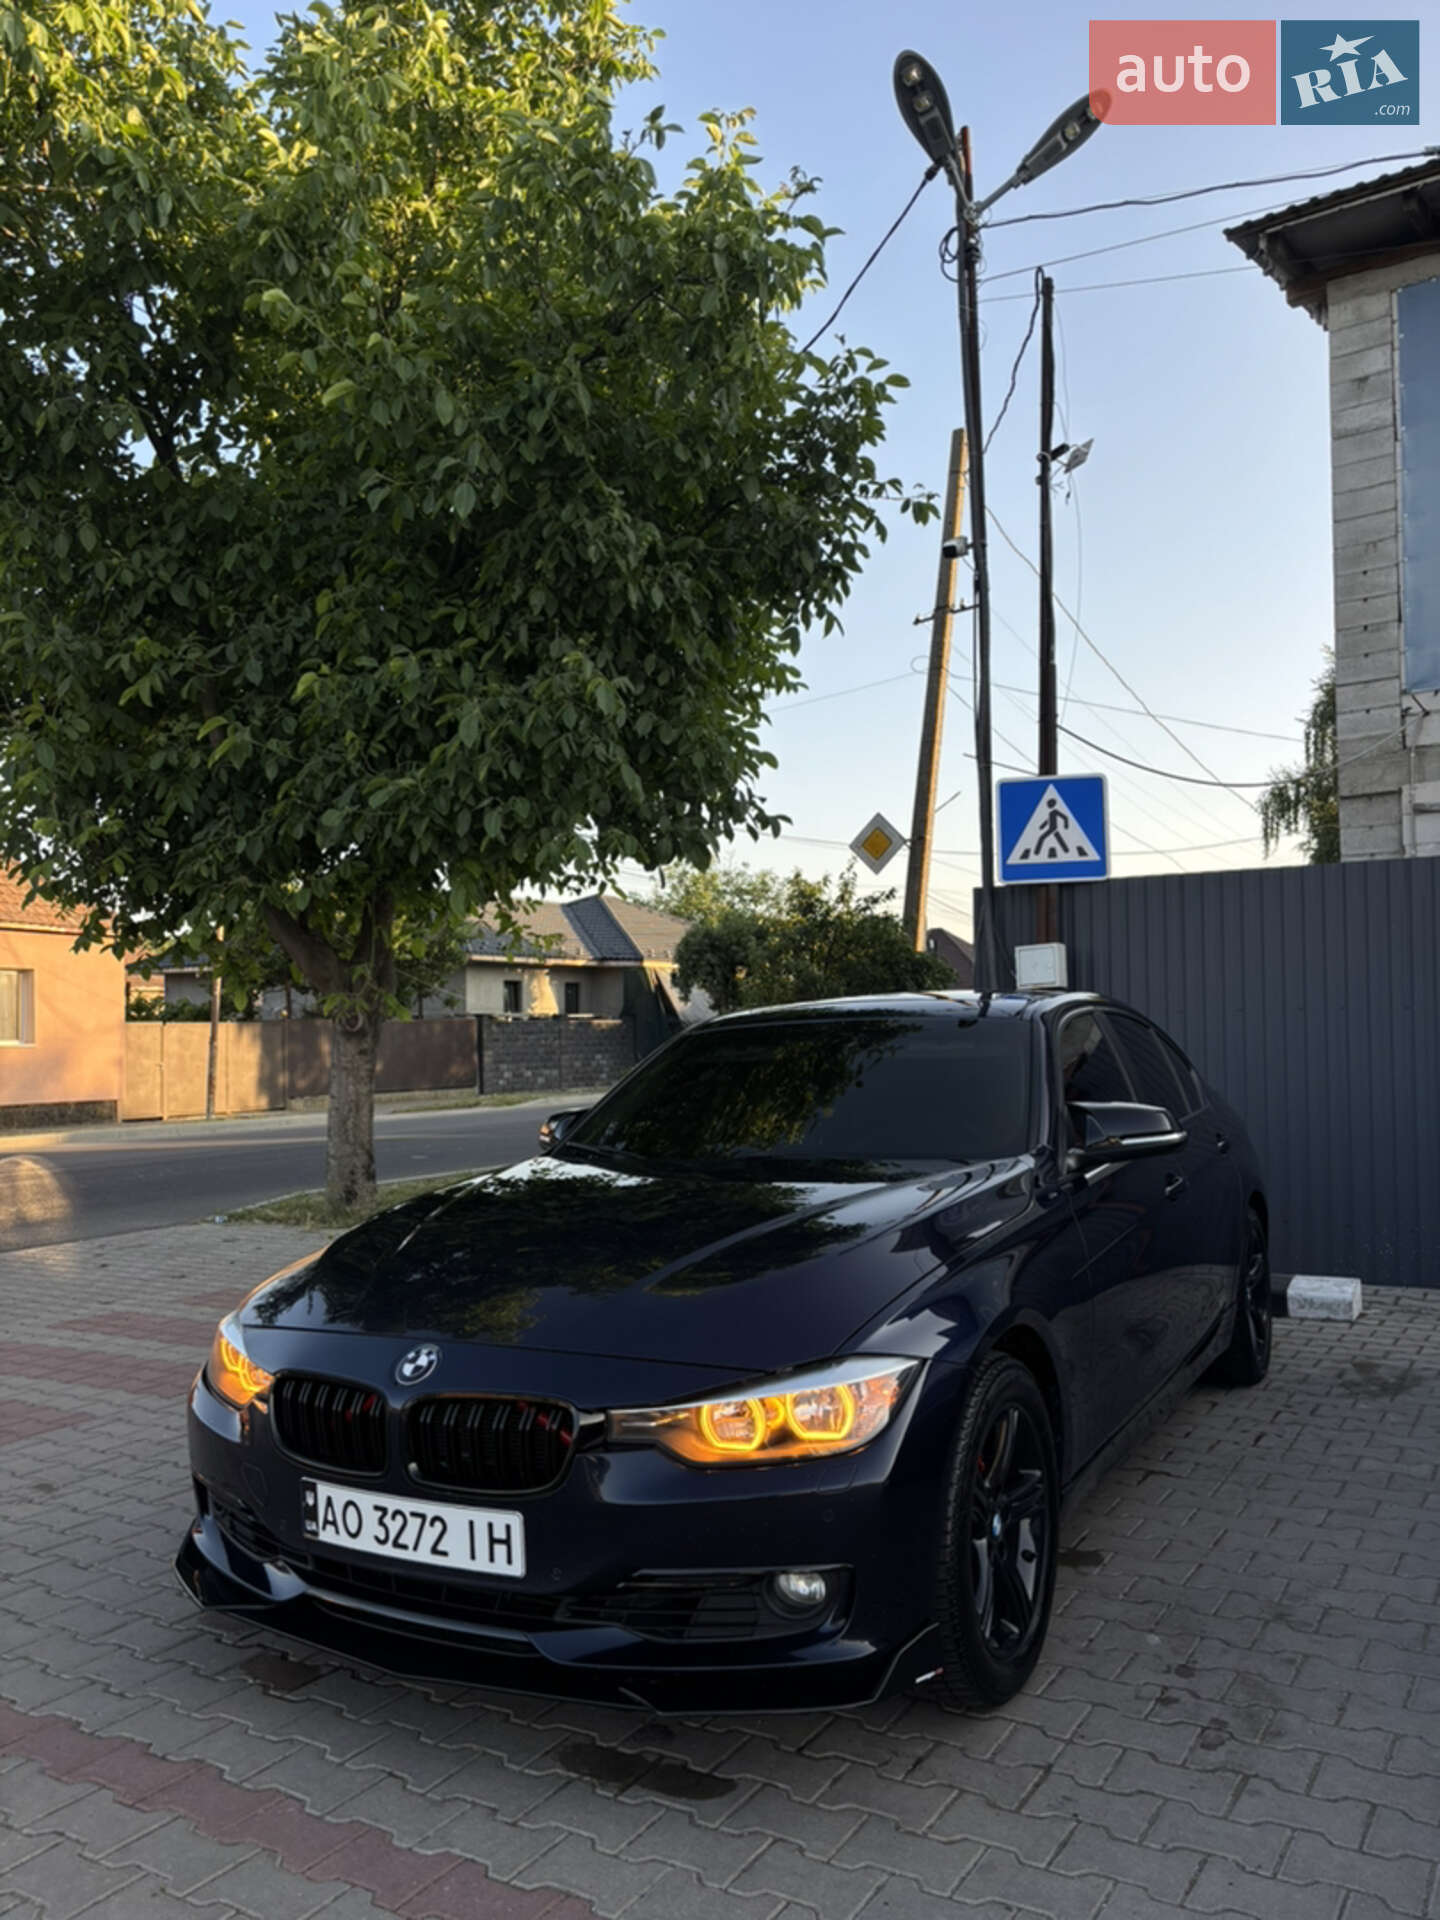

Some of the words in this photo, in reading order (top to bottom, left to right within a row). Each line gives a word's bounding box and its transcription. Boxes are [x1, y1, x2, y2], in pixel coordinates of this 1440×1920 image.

[321, 1496, 363, 1539] AO
[372, 1505, 449, 1557] 3272
[468, 1519, 513, 1565] IH
